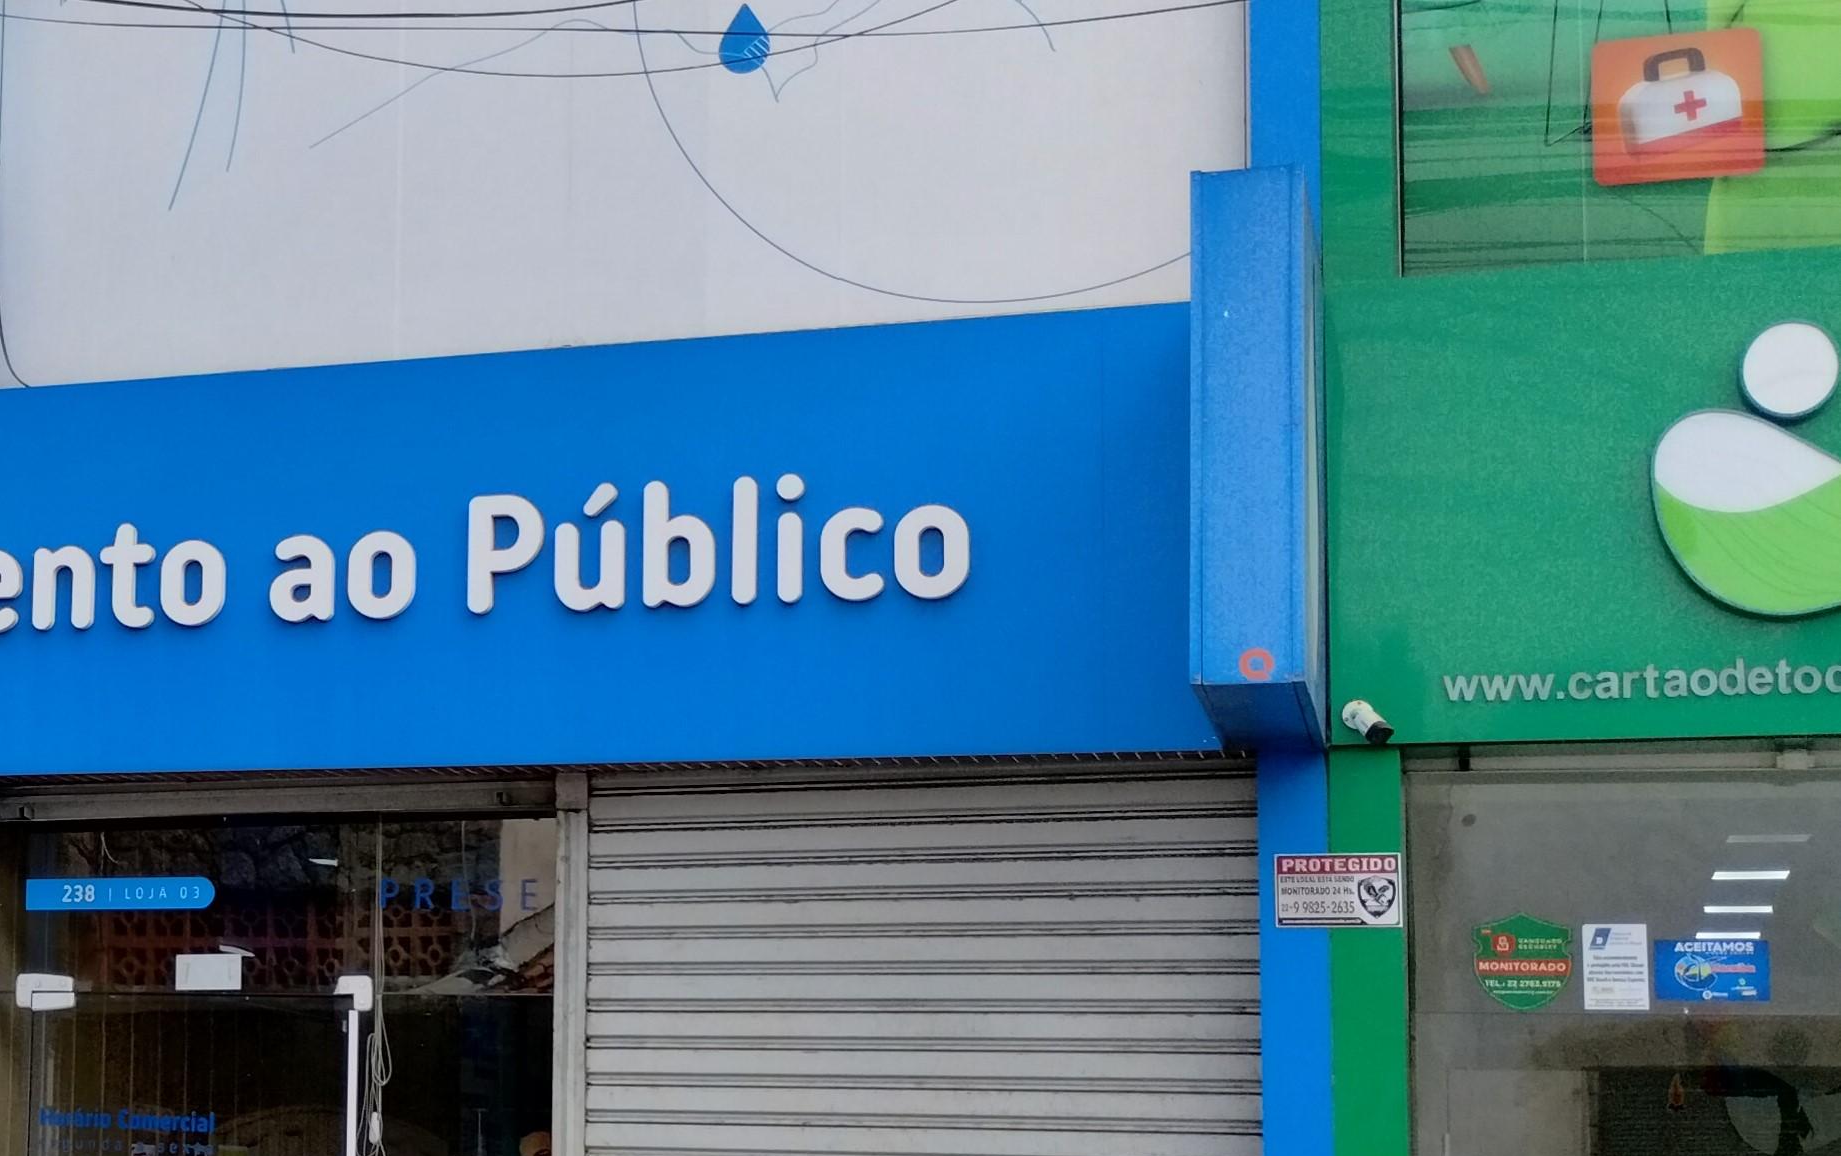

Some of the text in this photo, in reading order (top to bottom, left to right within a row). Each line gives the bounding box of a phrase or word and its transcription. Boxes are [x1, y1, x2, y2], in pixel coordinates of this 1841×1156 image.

[268, 530, 417, 623] ao
[466, 473, 971, 615] Público
[1281, 857, 1396, 873] PROTEGIDO
[62, 884, 200, 903] 238 LOJA 03
[1281, 886, 1331, 895] MONITORADO
[1674, 942, 1755, 953] ACEITAMOS
[1478, 961, 1567, 972] MONITORADO
[39, 1105, 217, 1134] Horário Comercial
